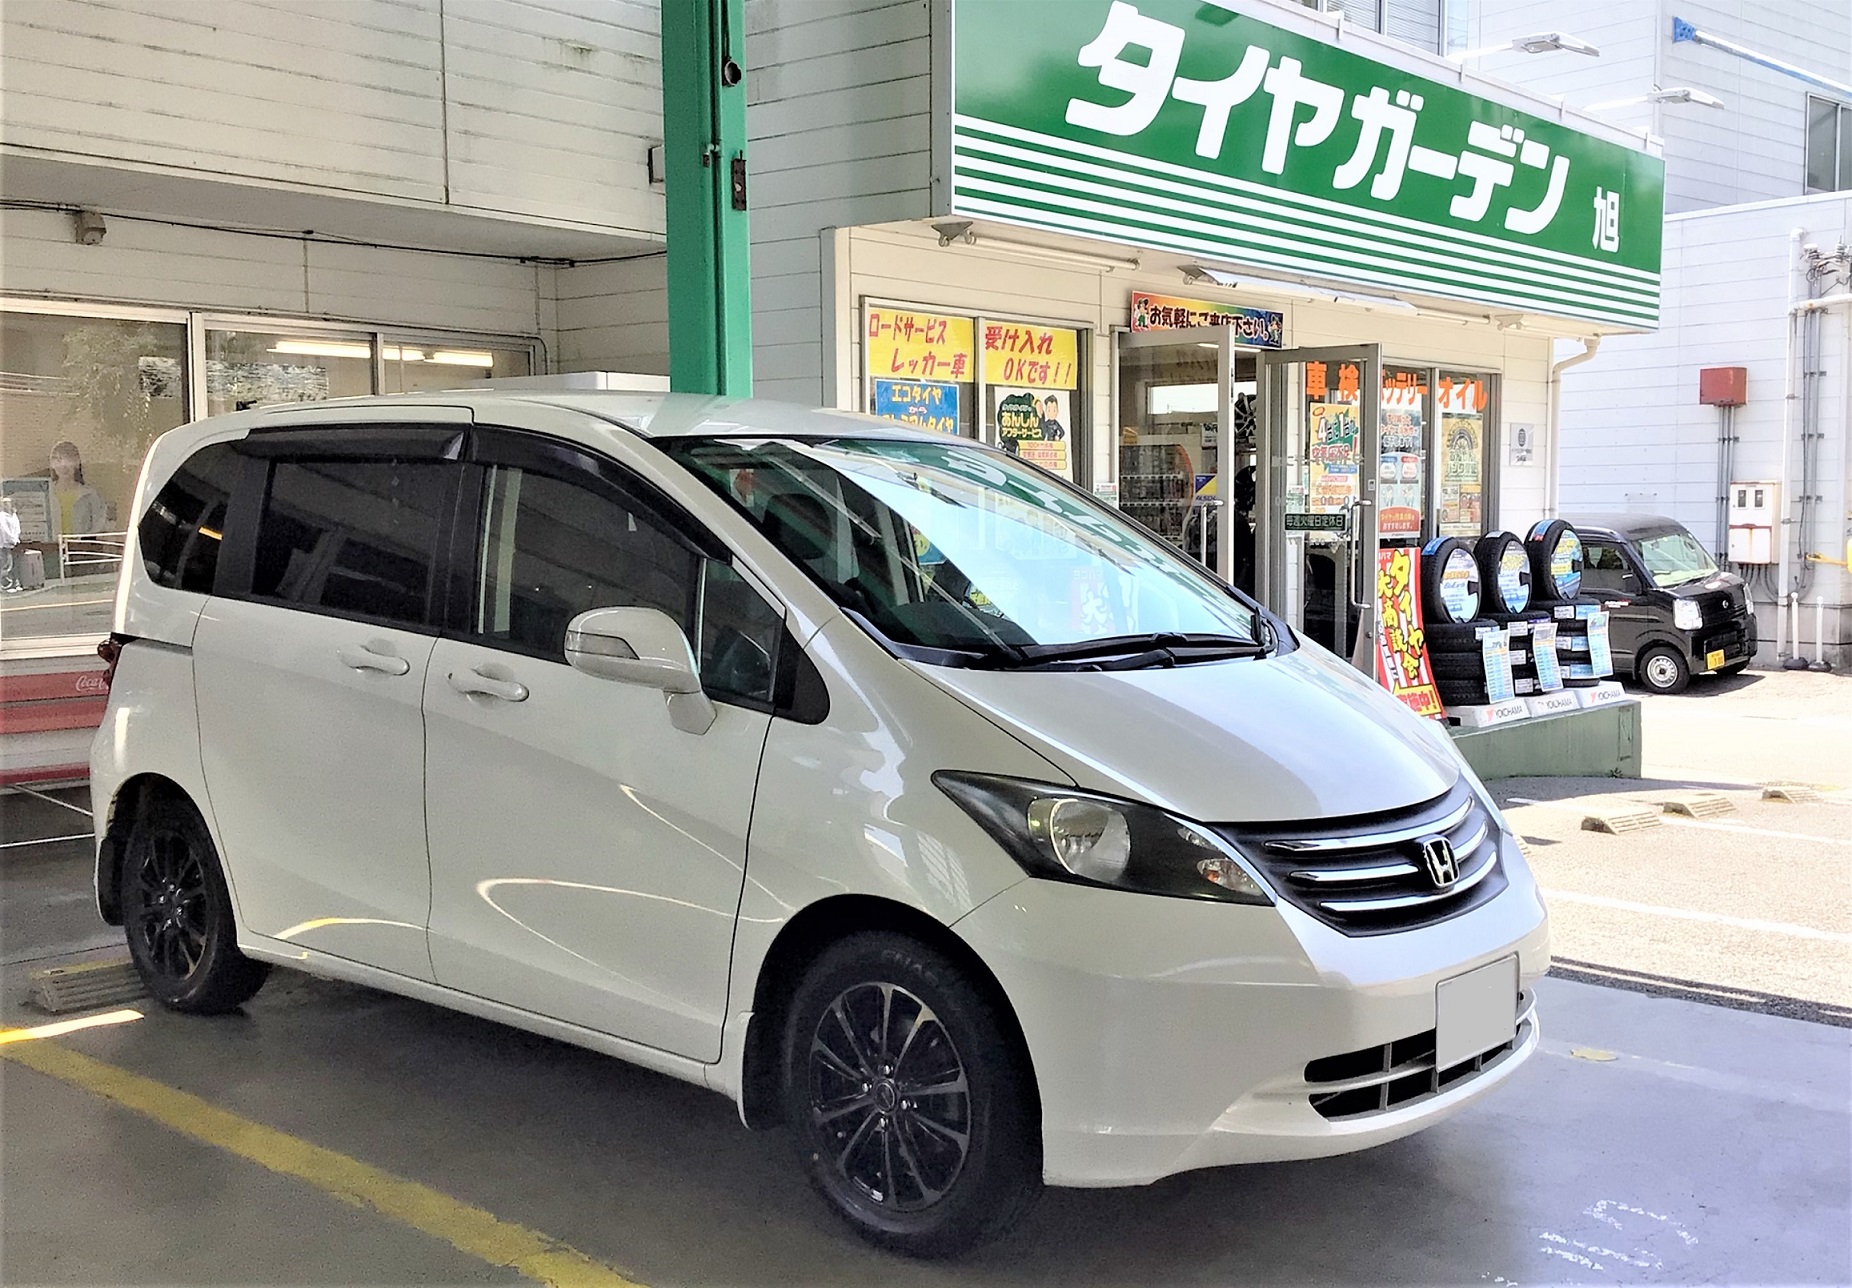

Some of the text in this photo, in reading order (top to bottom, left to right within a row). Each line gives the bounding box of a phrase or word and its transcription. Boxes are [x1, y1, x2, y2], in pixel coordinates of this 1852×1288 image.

[1066, 1, 1621, 254] タイヤガーデン 旭
[869, 313, 947, 345] ロードサービス
[985, 325, 1053, 354] 受け入れ
[890, 348, 968, 379] レッカー車
[892, 384, 942, 405] エコタイヤ
[1438, 376, 1487, 411] オイル
[1002, 412, 1038, 427] あんしん
[1002, 427, 1042, 438] アフターサービス
[1286, 515, 1344, 527] 毎週火曜日定休日
[1390, 549, 1425, 658] タイヤ
